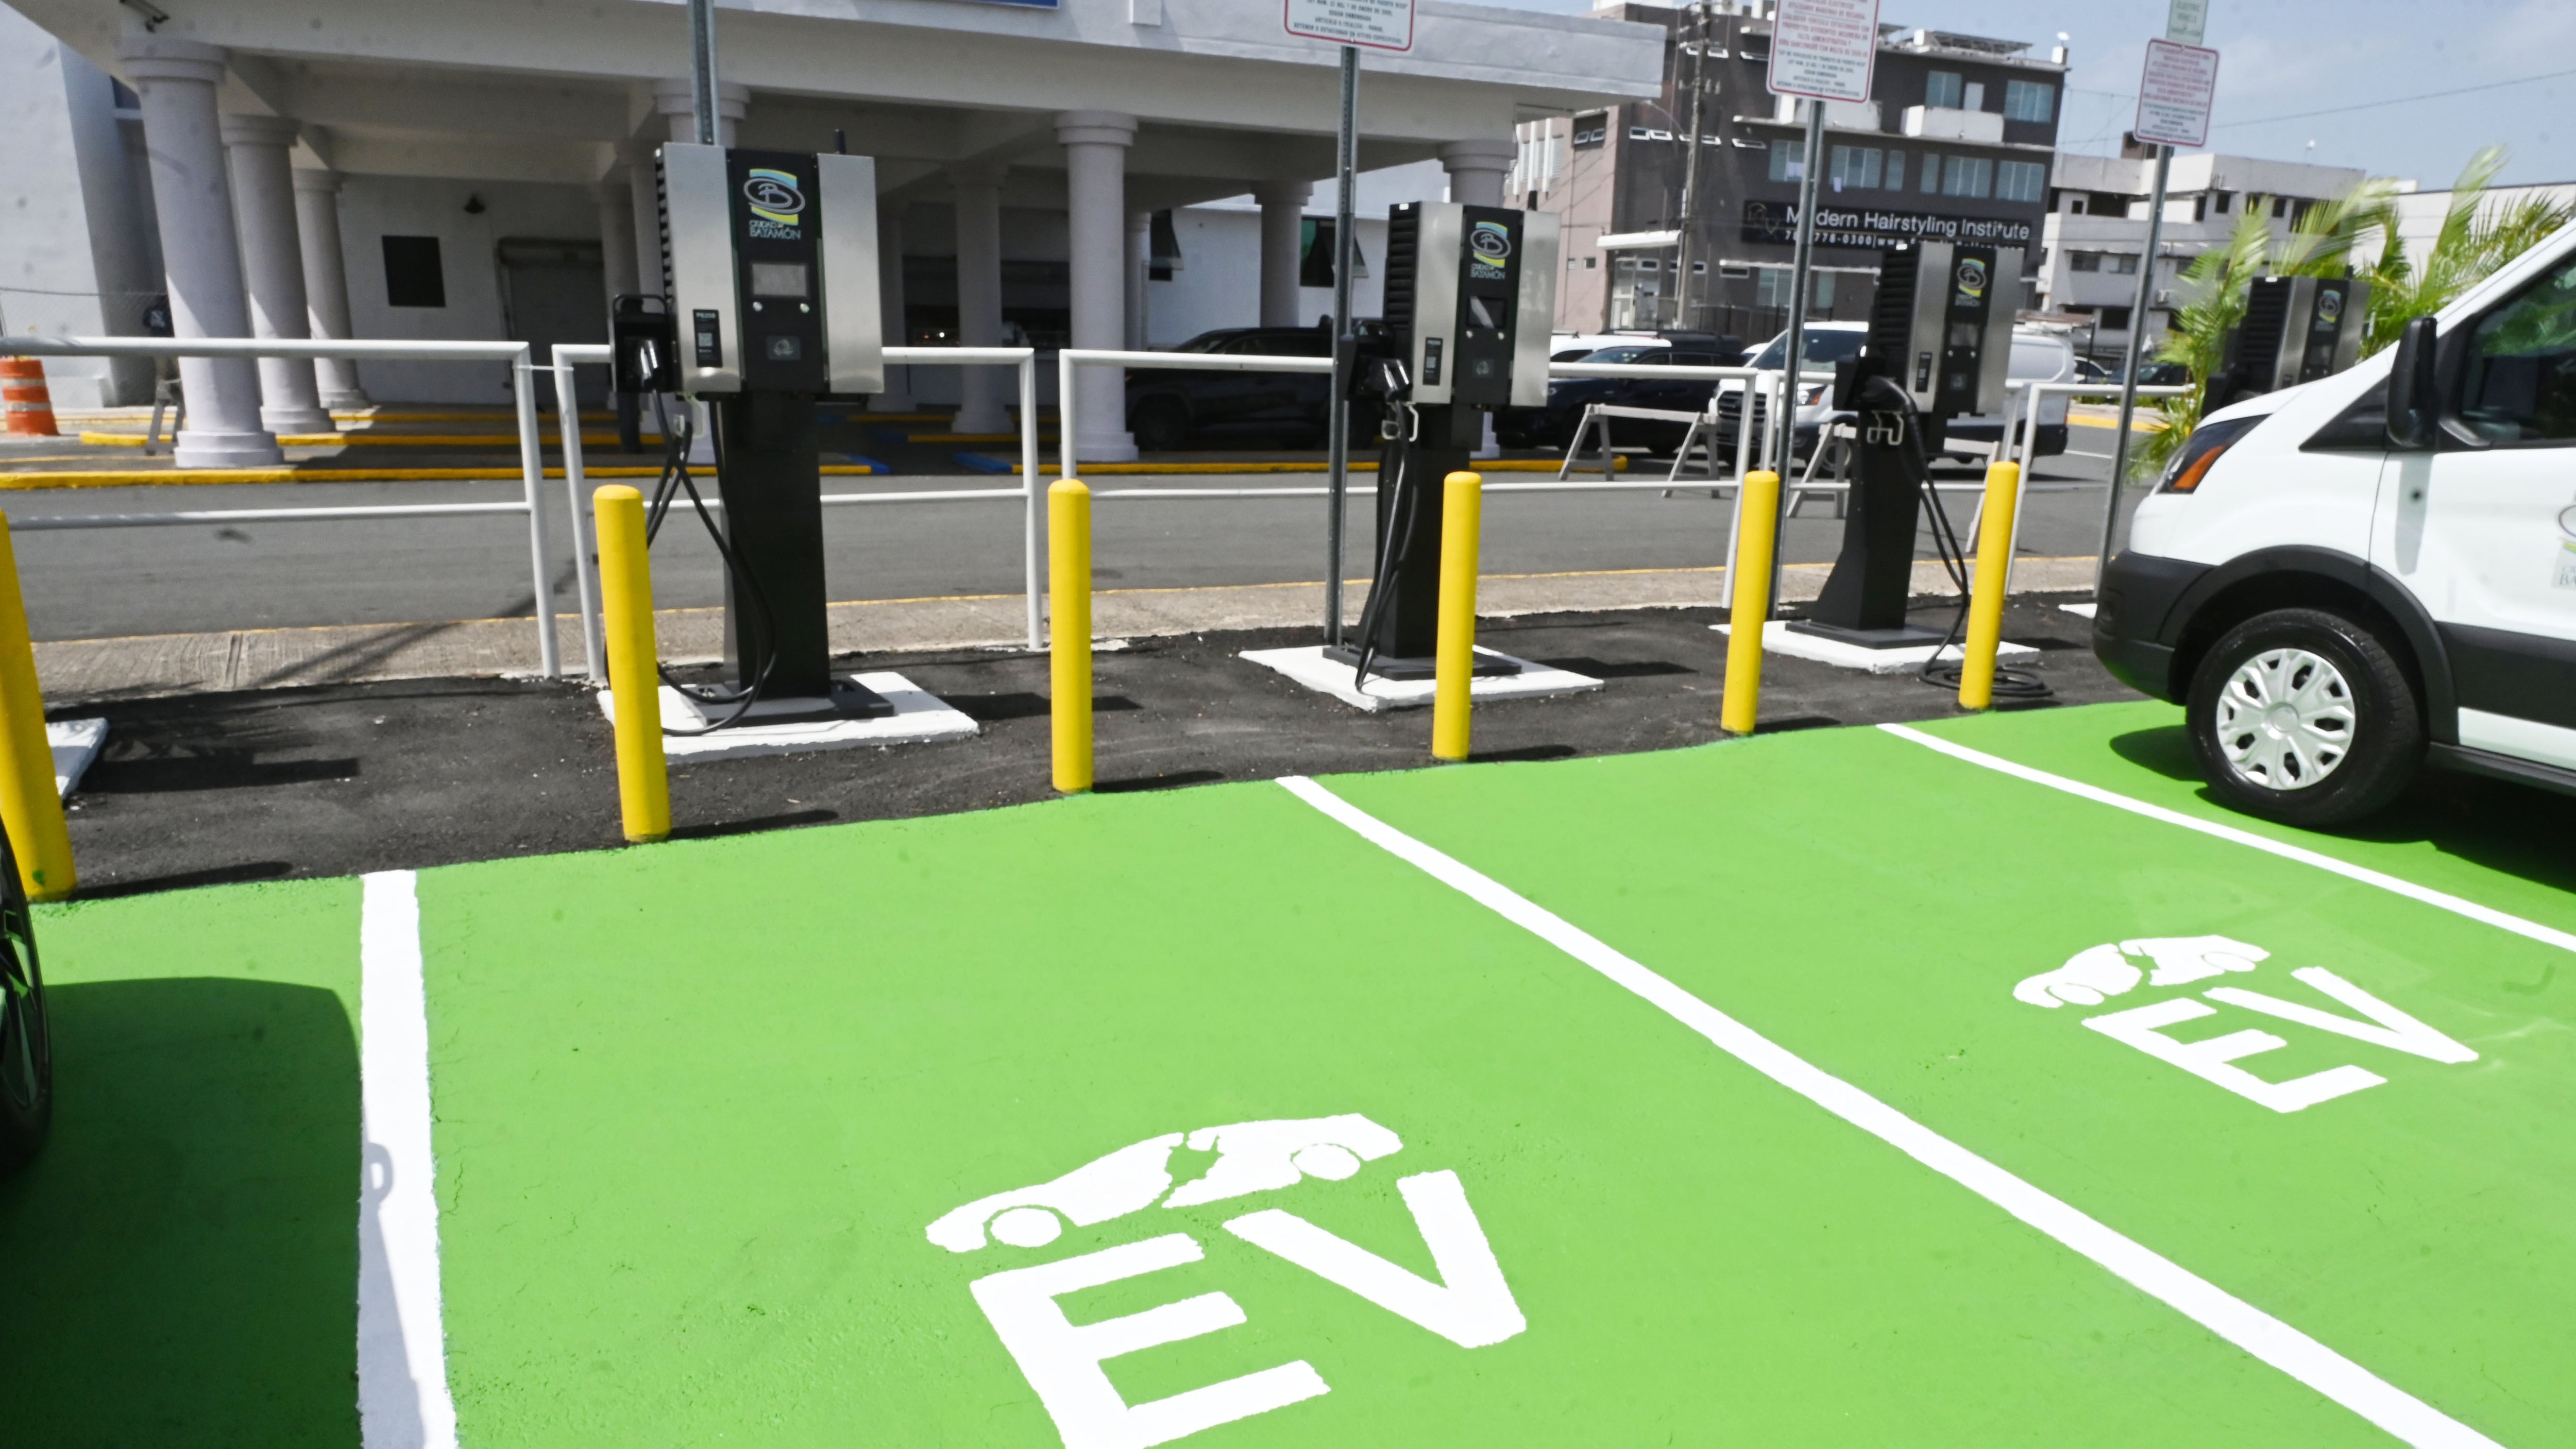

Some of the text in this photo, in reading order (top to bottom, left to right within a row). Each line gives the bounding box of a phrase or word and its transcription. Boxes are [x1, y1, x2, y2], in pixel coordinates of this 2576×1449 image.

[1786, 206, 1858, 227] Mdern
[1864, 212, 1957, 237] Hairstyling
[2081, 966, 2479, 1113] EV
[969, 1169, 1527, 1449] EV
